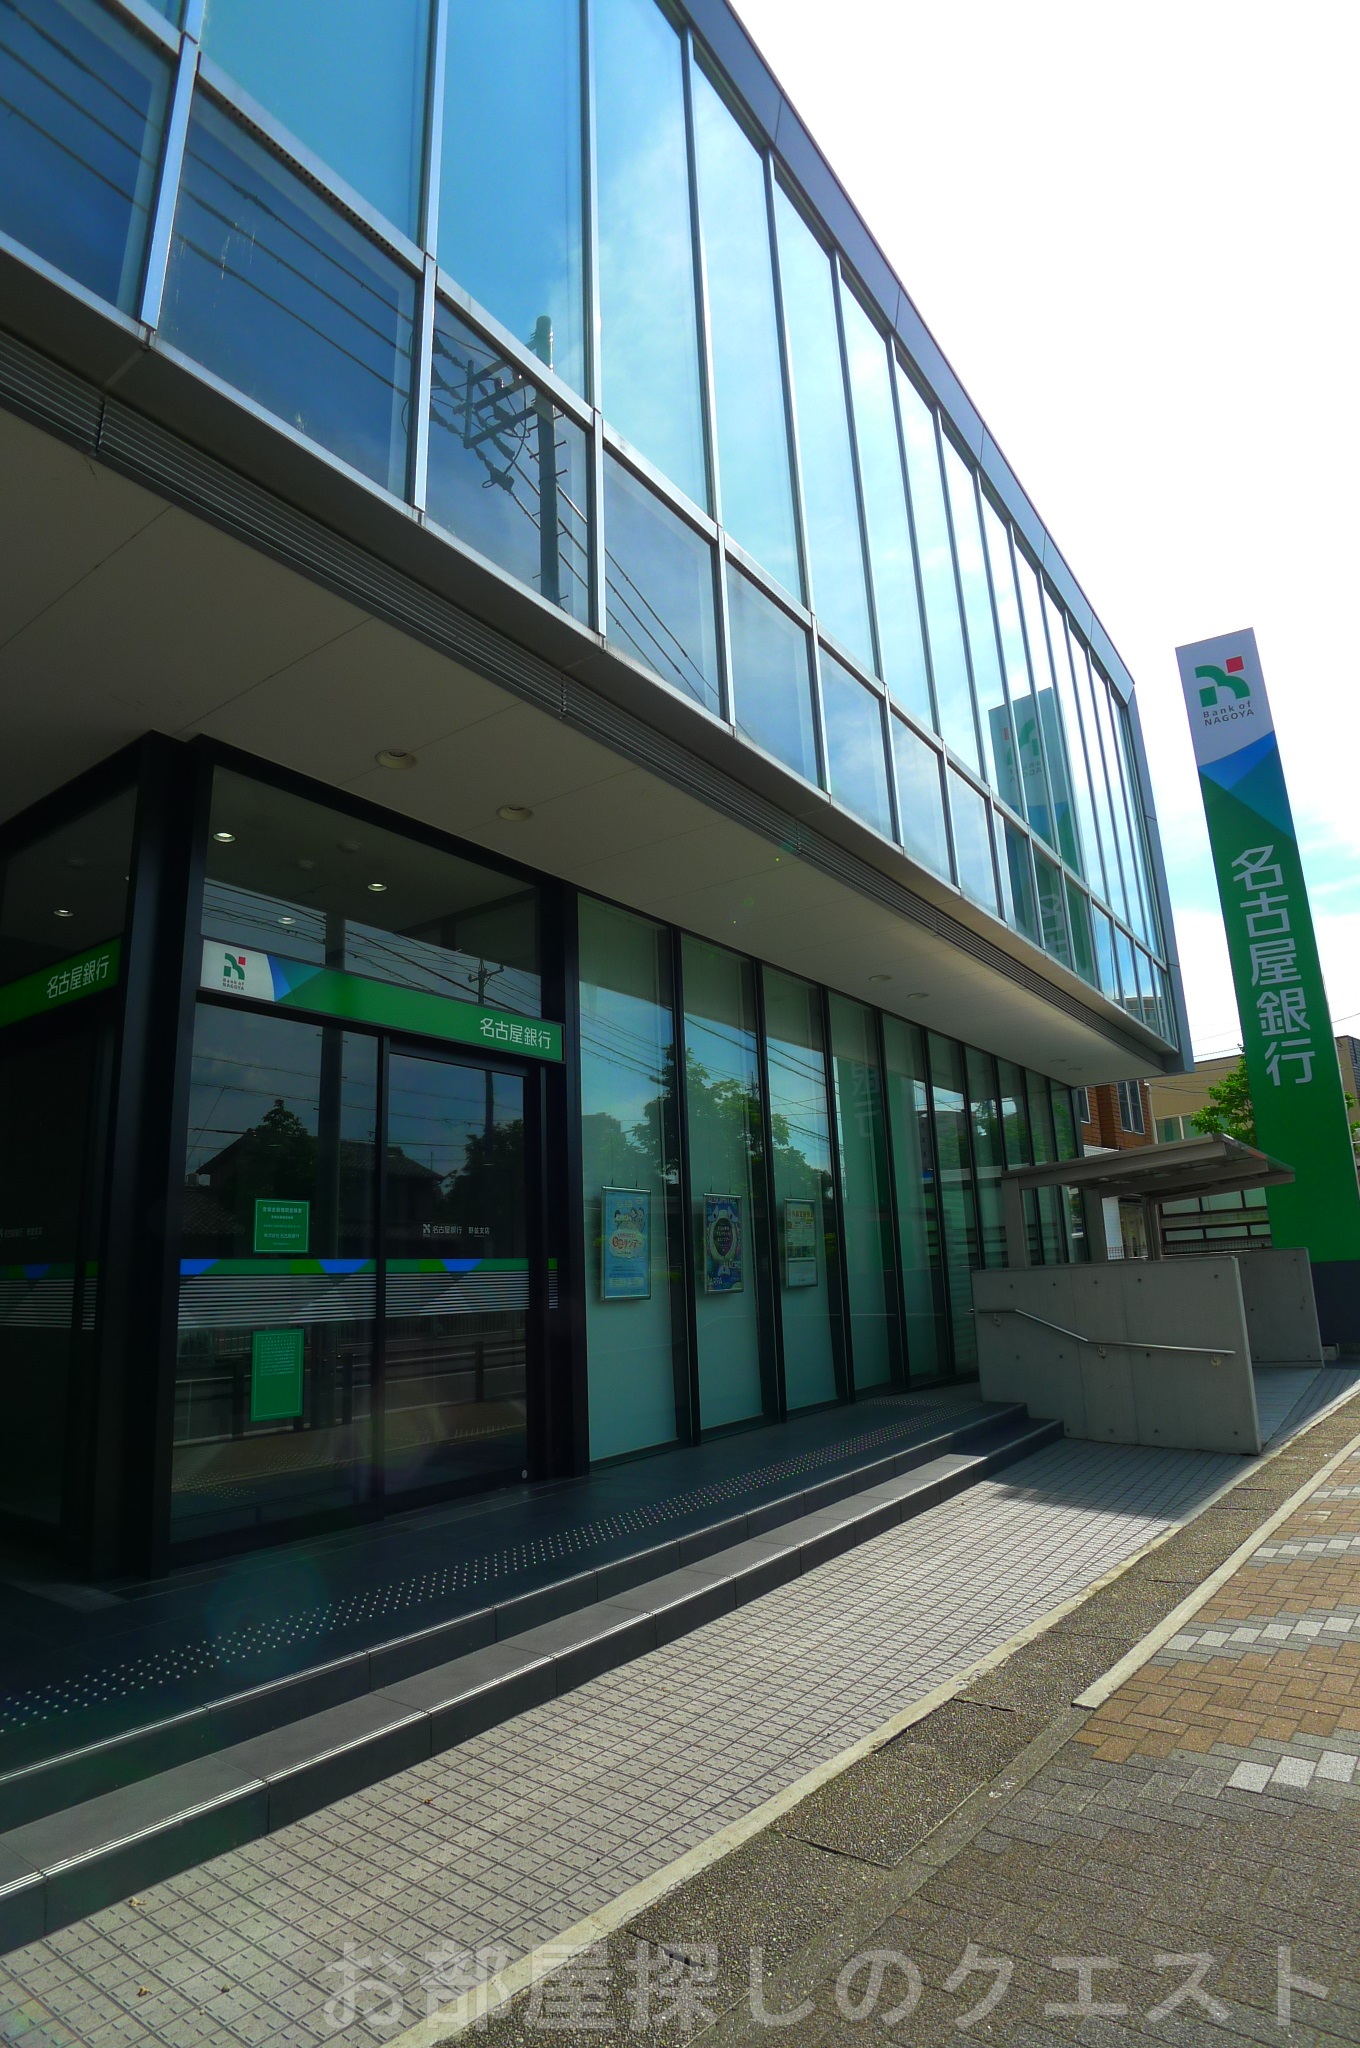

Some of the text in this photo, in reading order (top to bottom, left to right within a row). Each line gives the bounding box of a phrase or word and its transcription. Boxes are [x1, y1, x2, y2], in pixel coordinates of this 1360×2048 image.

[1203, 700, 1251, 718] Bank of
[1204, 709, 1255, 726] NAGOYA
[1230, 843, 1316, 1088] 名古屋銀行
[46, 954, 110, 999] 名古屋銀行
[222, 977, 237, 986] Bank
[222, 982, 245, 991] NAGOYA
[479, 1017, 552, 1050] 名古屋銀行
